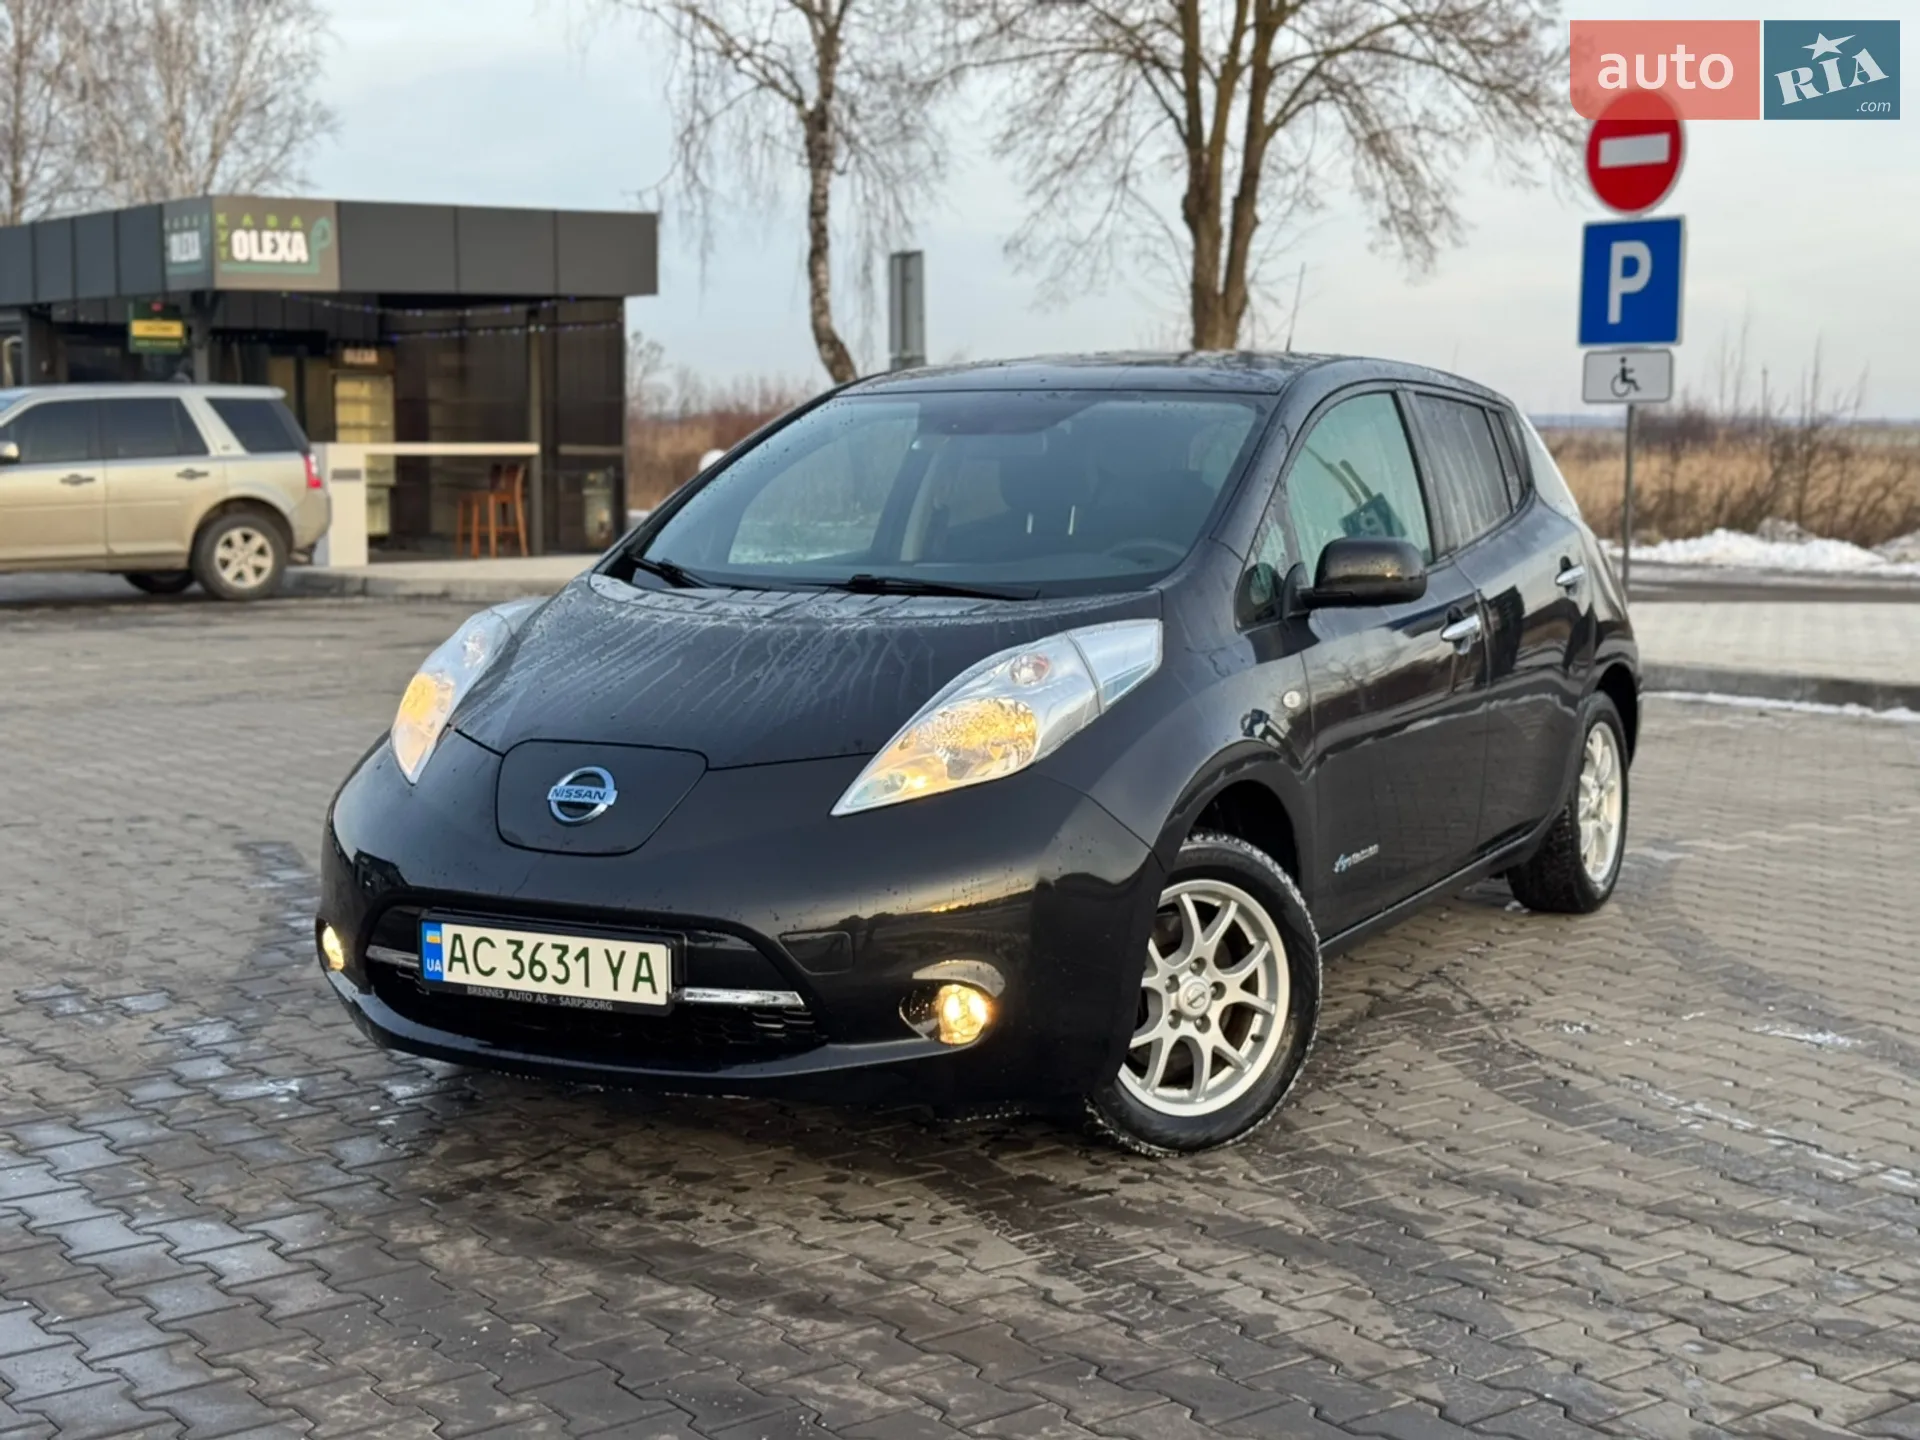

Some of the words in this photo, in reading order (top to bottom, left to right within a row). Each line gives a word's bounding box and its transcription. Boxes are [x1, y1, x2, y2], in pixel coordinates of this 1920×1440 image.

[231, 228, 309, 263] OLEXA
[1607, 240, 1653, 325] P
[551, 788, 607, 801] NISSAN
[426, 958, 443, 973] UA
[447, 933, 498, 978] AC
[506, 938, 590, 989] 3631
[604, 948, 658, 995] YA
[467, 985, 505, 999] BRENNES
[507, 990, 532, 1002] AUTO
[535, 993, 548, 1004] AS
[559, 996, 613, 1011] SARPSBORG
